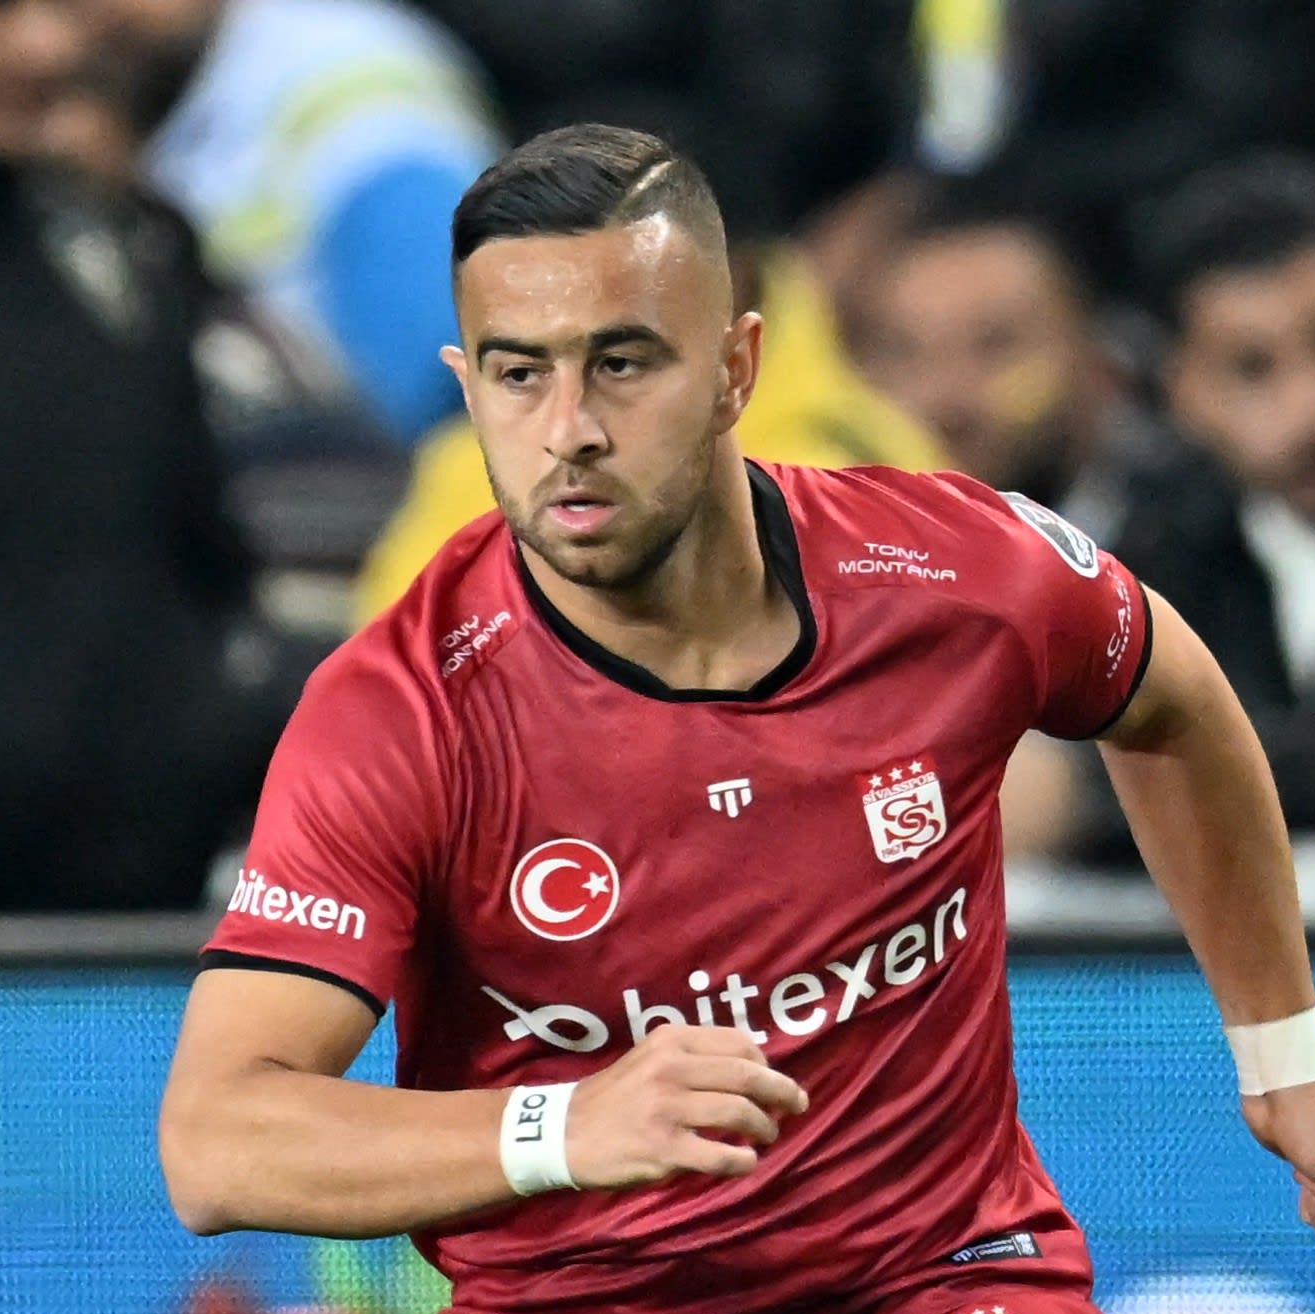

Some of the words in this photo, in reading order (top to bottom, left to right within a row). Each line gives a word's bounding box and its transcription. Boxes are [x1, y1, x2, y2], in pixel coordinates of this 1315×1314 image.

[864, 542, 929, 562] TONY
[838, 560, 956, 582] MONTANA
[442, 615, 479, 648] ONY
[227, 868, 366, 940] bitexen
[515, 1093, 547, 1142] LEO
